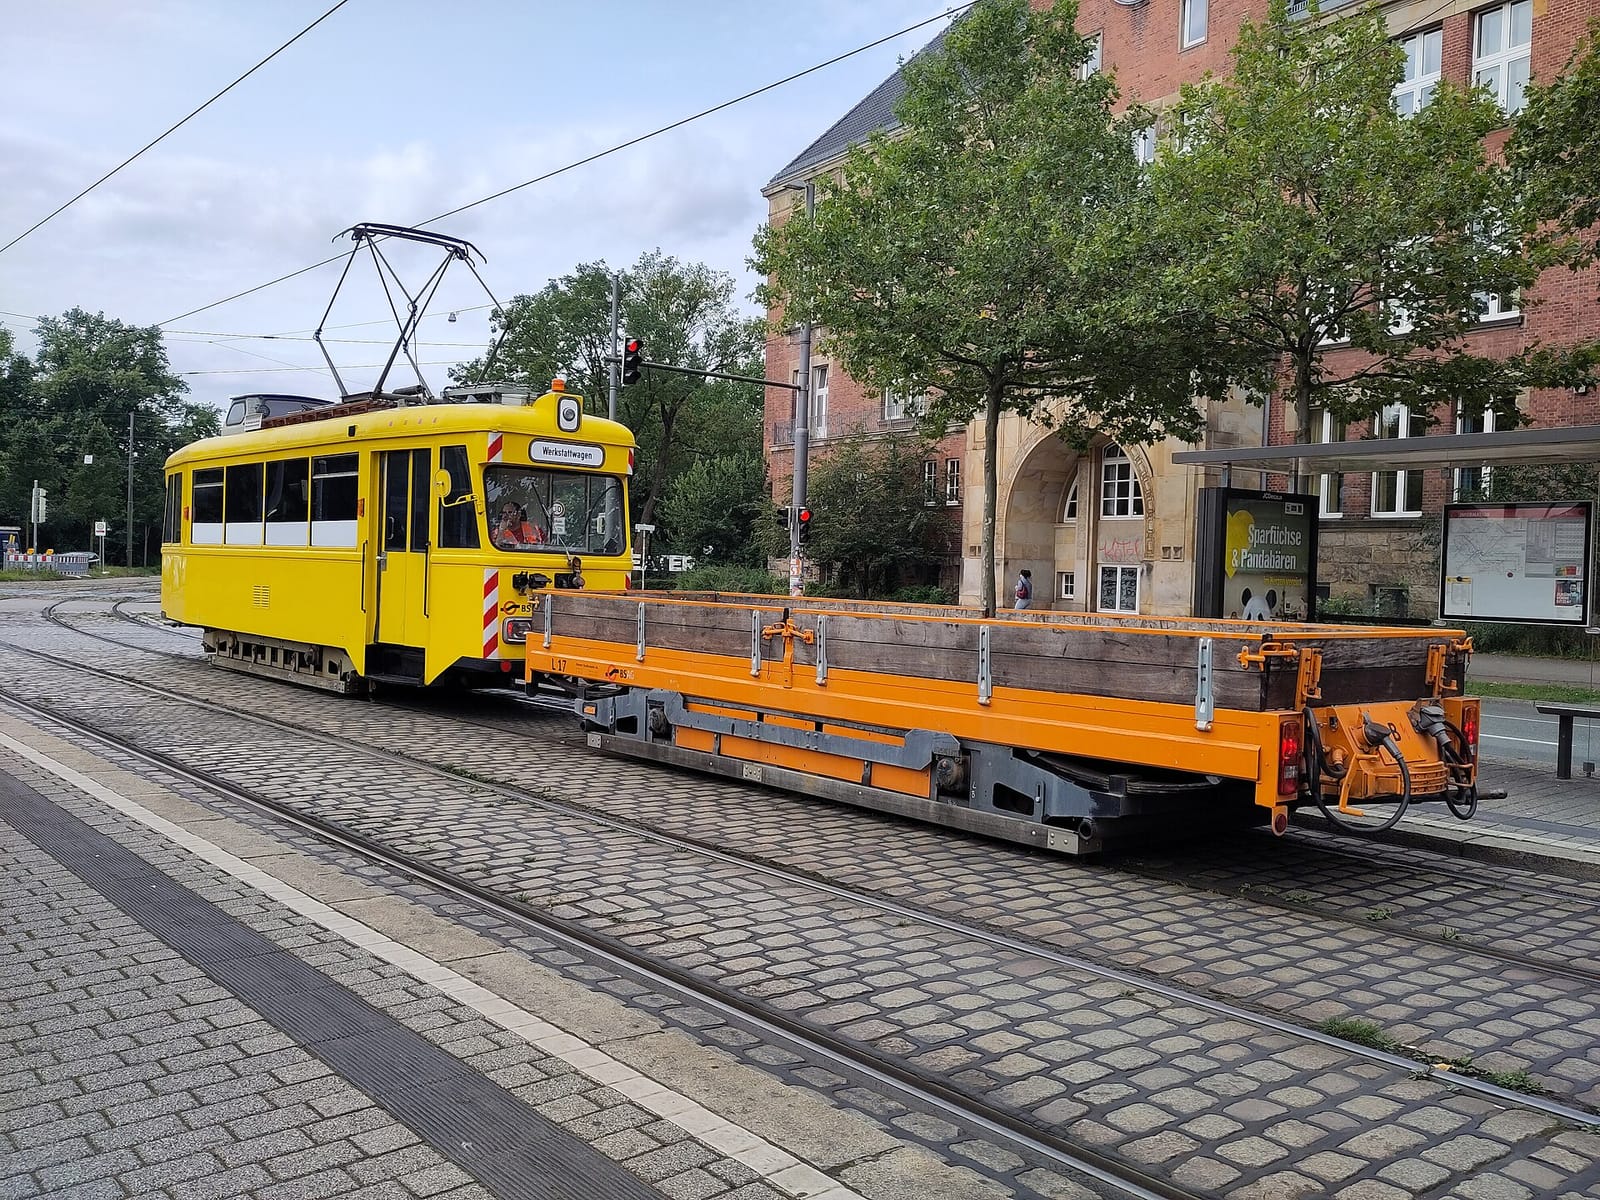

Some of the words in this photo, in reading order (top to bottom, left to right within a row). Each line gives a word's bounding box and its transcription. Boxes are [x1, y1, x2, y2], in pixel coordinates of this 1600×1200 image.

[542, 446, 593, 461] Werkstattwagen
[1248, 524, 1302, 548] Sparfüchse
[1231, 549, 1239, 568] &
[1241, 548, 1297, 570] Pandabären
[551, 657, 556, 671] L
[557, 659, 567, 672] 17
